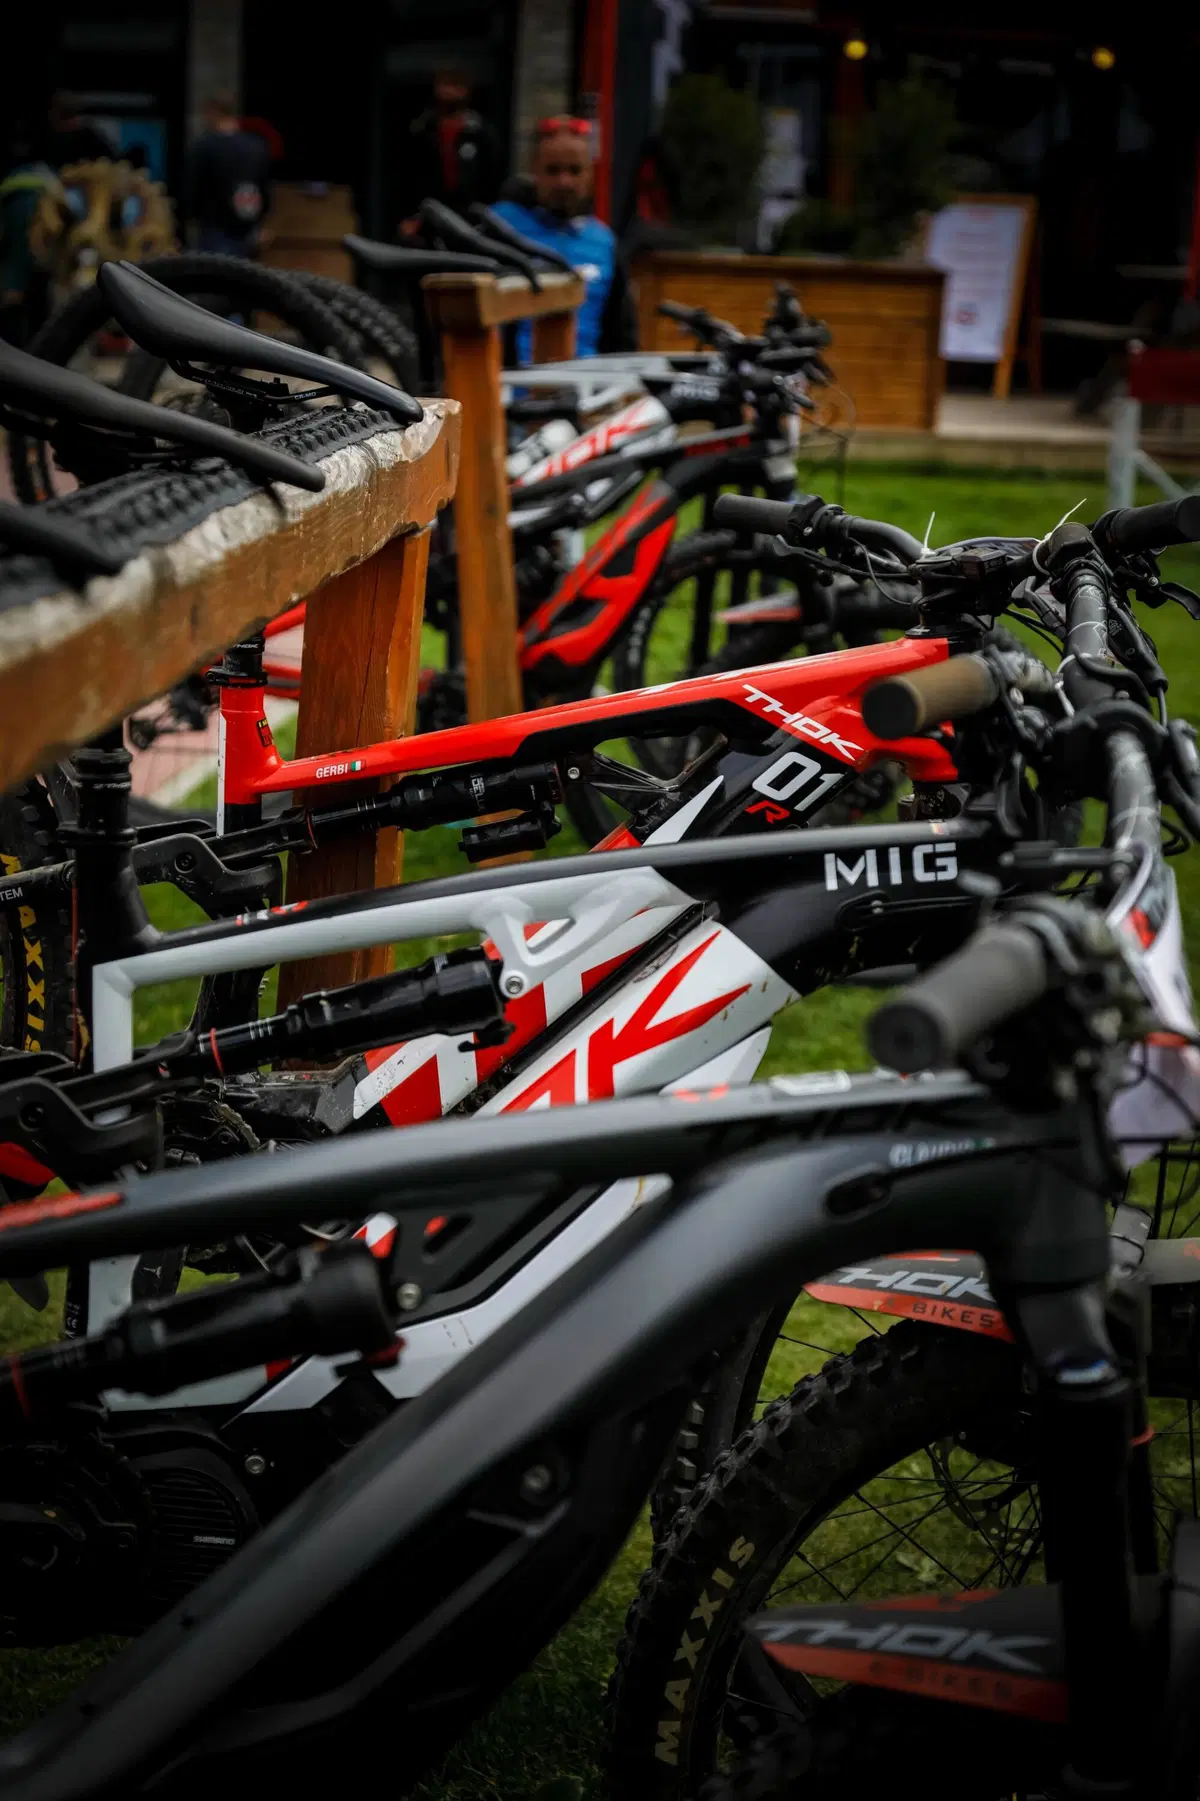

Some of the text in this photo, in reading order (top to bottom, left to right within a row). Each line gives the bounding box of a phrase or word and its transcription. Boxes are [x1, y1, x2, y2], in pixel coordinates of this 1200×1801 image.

[742, 684, 865, 761] THOK
[315, 763, 348, 779] GERBI
[752, 751, 845, 812] 01
[745, 800, 791, 824] R
[823, 841, 958, 892] MIG
[911, 1301, 996, 1329] BIKES
[653, 1535, 756, 1768] MAXXIS
[754, 1618, 1054, 1673] THOK
